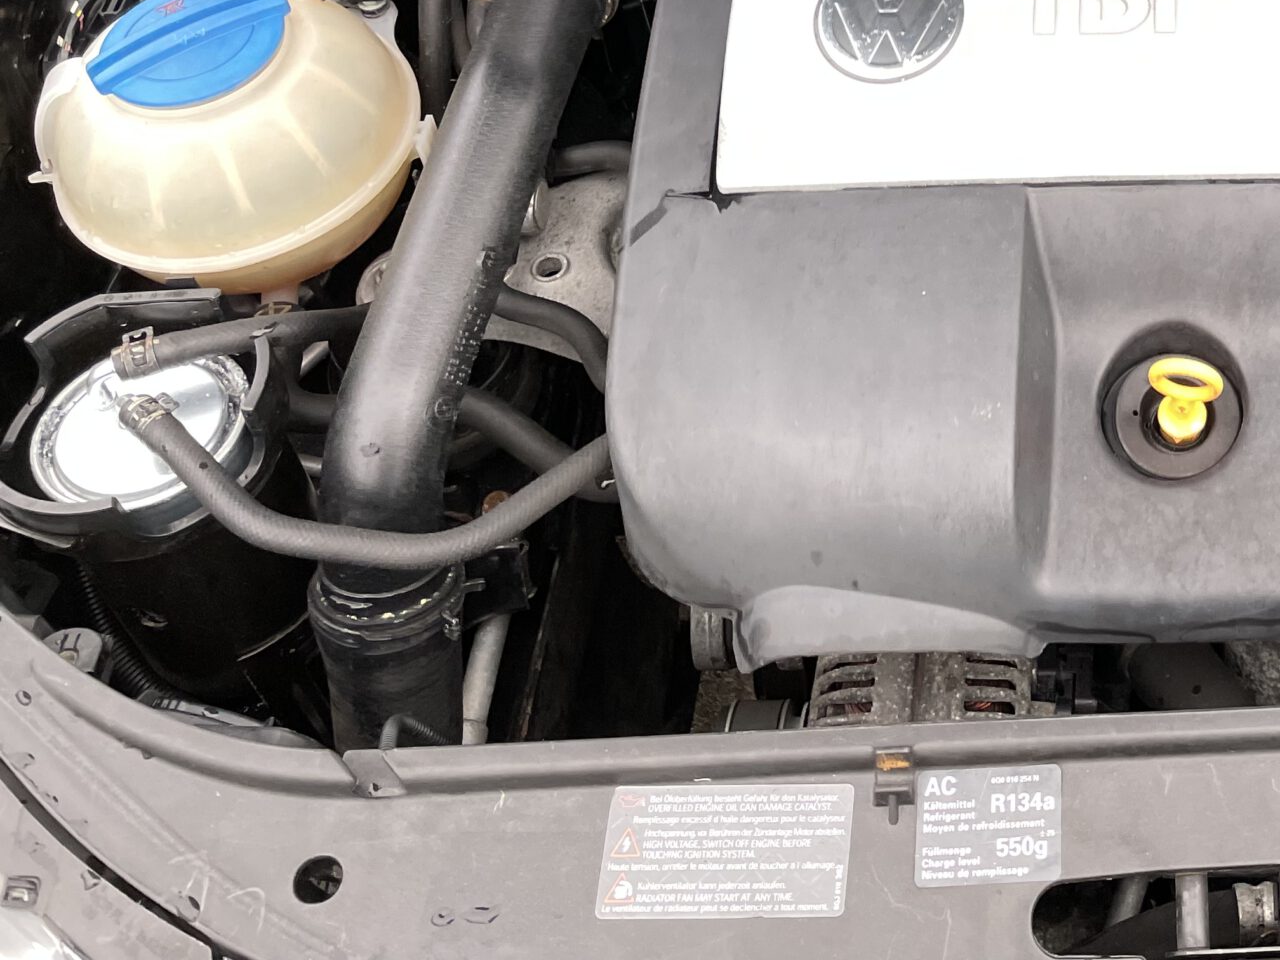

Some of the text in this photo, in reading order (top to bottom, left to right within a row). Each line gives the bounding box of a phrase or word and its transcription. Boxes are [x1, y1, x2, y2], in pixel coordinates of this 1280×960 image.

[924, 776, 957, 796] AC
[650, 794, 662, 803] Bei
[990, 792, 1055, 813] R134a
[648, 803, 693, 812] OVERFILLED
[695, 803, 724, 812] ENGINE
[726, 803, 737, 812] OIL
[740, 803, 757, 812] CAN
[758, 802, 792, 811] DAMAGE
[781, 815, 797, 825] pour
[799, 816, 806, 824] le
[923, 811, 976, 823] Refrigerant
[923, 819, 1045, 834] Moyen de refroidissement
[643, 840, 663, 849] HIGH
[702, 840, 734, 849] SWITCH
[736, 840, 749, 849] OFF
[751, 839, 780, 848] ENGINE
[782, 839, 811, 848] BEFORE
[996, 835, 1048, 860] 550g
[642, 850, 682, 859] TOUCHING
[922, 847, 972, 857] Füllmenge
[690, 863, 697, 871] le
[728, 863, 747, 871] avant
[748, 862, 757, 870] de
[759, 862, 787, 870] toucher
[922, 856, 980, 869] Charge level
[922, 866, 1029, 880] Niveau de remplissage
[698, 882, 716, 890] kann
[636, 893, 676, 902] RADIATOR
[677, 893, 693, 902] FAN
[695, 893, 712, 902] MAY
[714, 893, 739, 902] START
[740, 893, 751, 902] AT
[754, 893, 771, 902] ANY
[602, 904, 611, 912] Le
[612, 904, 653, 912] ventilateur
[655, 904, 663, 912] de
[664, 904, 699, 912] radiateur
[701, 904, 718, 913] peut
[719, 904, 729, 912] se
[781, 904, 796, 912] tout
